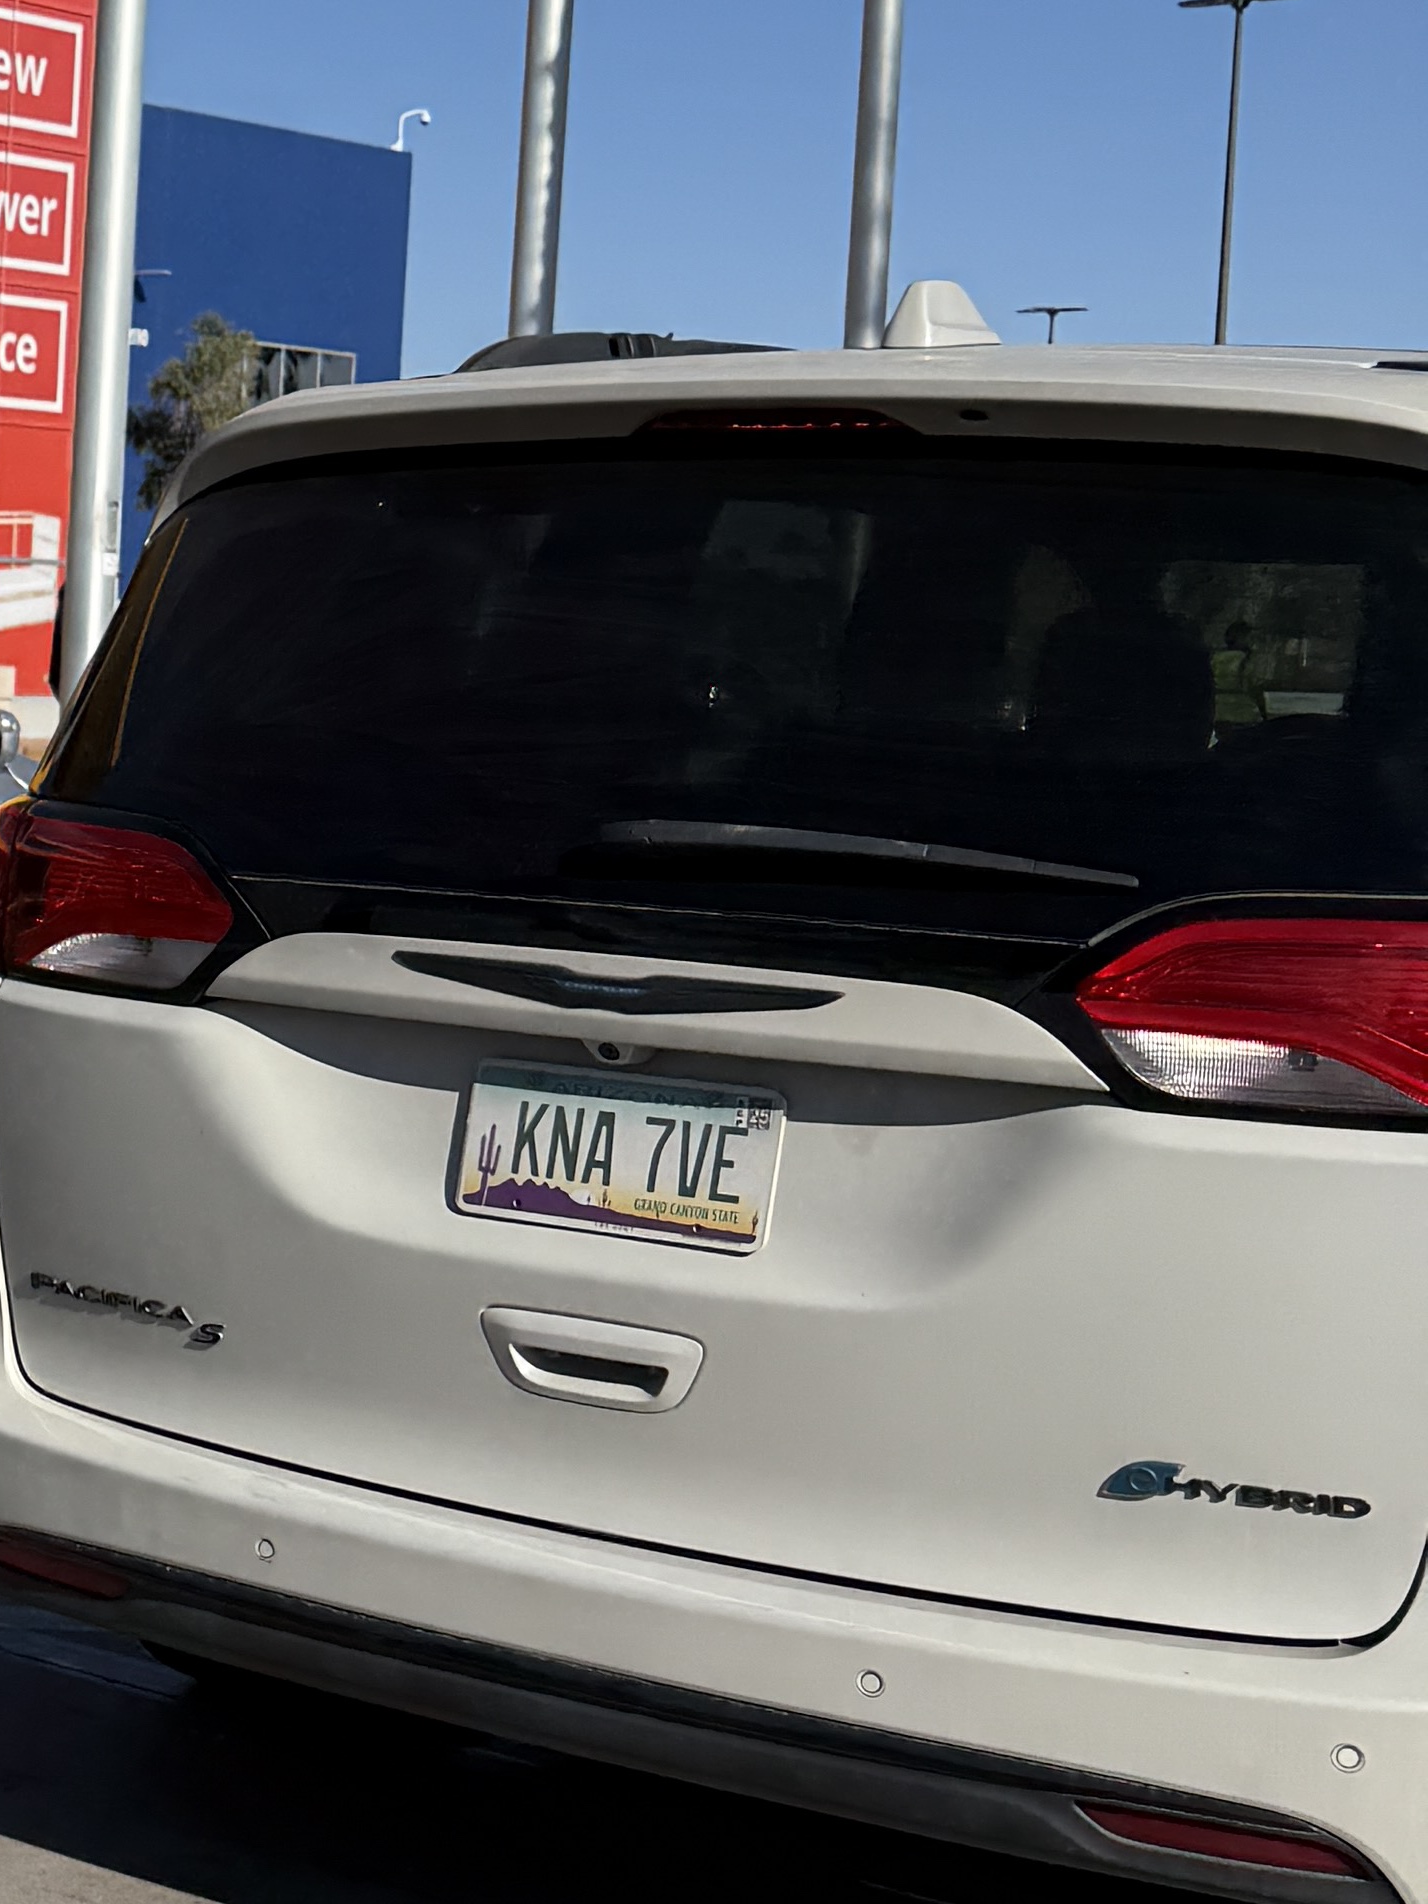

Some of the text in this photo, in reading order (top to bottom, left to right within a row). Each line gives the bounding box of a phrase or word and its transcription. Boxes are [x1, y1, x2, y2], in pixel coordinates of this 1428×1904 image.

[511, 1100, 749, 1204] KNA 7VE
[670, 1202, 709, 1220] CANYON
[712, 1208, 741, 1225] STATE
[30, 1271, 227, 1346] PACIFICA S
[1171, 1476, 1373, 1520] HYBRID
